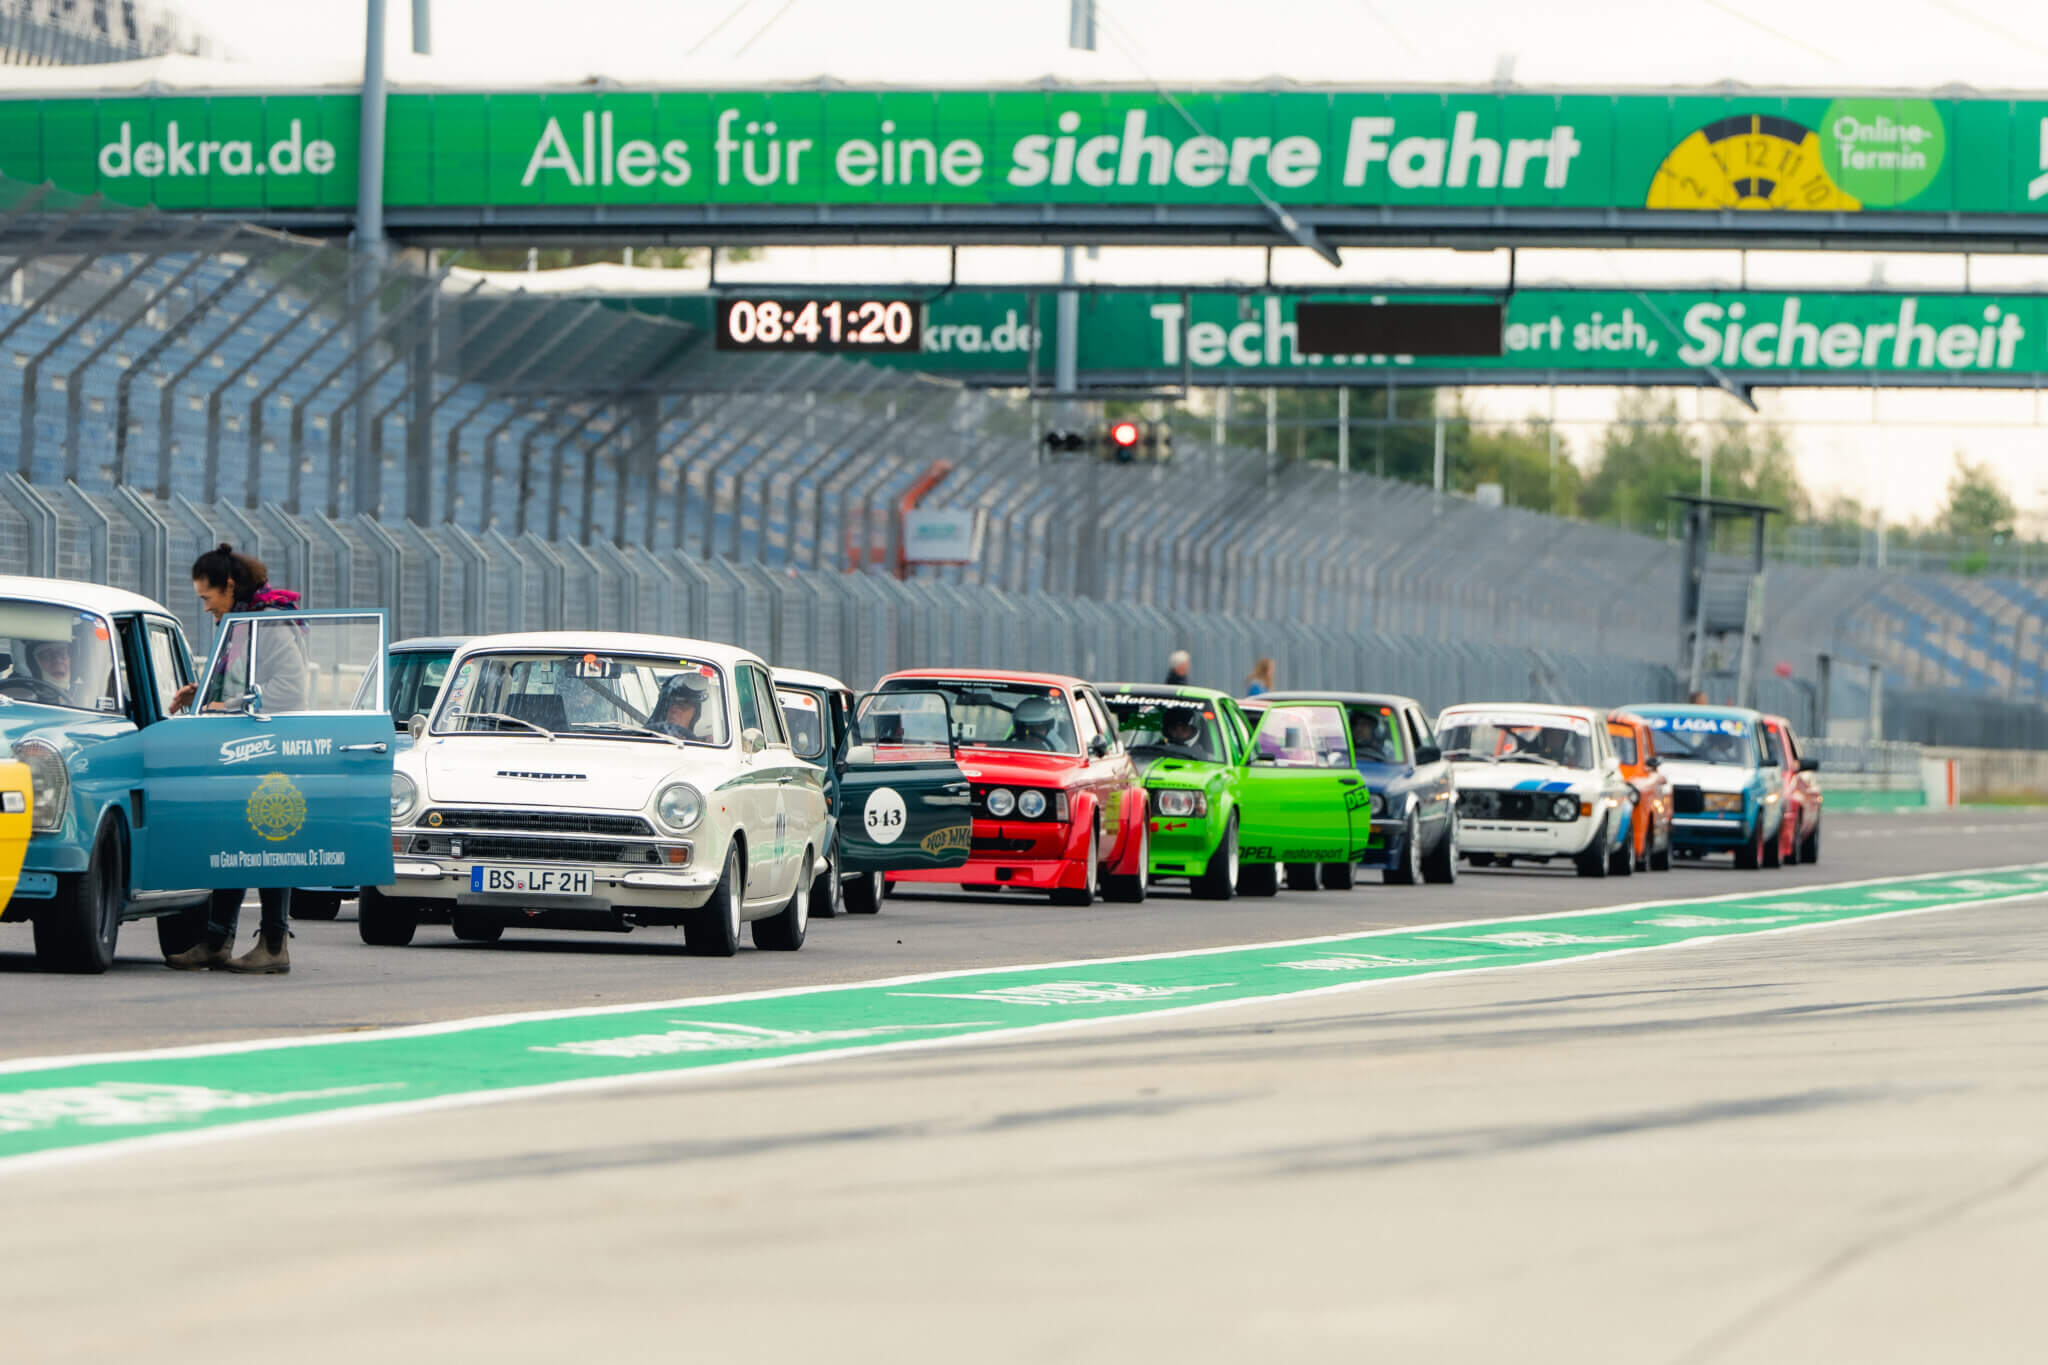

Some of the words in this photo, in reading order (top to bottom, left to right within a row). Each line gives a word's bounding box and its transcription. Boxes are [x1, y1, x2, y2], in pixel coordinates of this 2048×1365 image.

[1832, 115, 1933, 143] Online-
[98, 118, 337, 178] dekra.de
[522, 110, 691, 187] Alles
[714, 108, 812, 186] für
[835, 120, 984, 186] eine
[1007, 109, 1321, 188] sichere
[1343, 111, 1581, 188] Fahrt
[1744, 140, 1770, 167] 12
[1838, 143, 1926, 170] Termin
[1780, 150, 1803, 178] 11
[1801, 175, 1830, 206] 10
[728, 300, 914, 344] 08:41:20
[922, 307, 1042, 352] kra.de
[1573, 309, 1658, 356] sich,
[1677, 297, 2025, 370] Sicherheit
[1672, 718, 1718, 732] LADA
[219, 734, 277, 765] Super
[282, 739, 313, 756] NAFTA
[314, 738, 333, 755] YPF
[868, 809, 902, 827] 543
[489, 869, 515, 889] BS
[529, 871, 555, 891] LF
[560, 872, 587, 893] 2H
